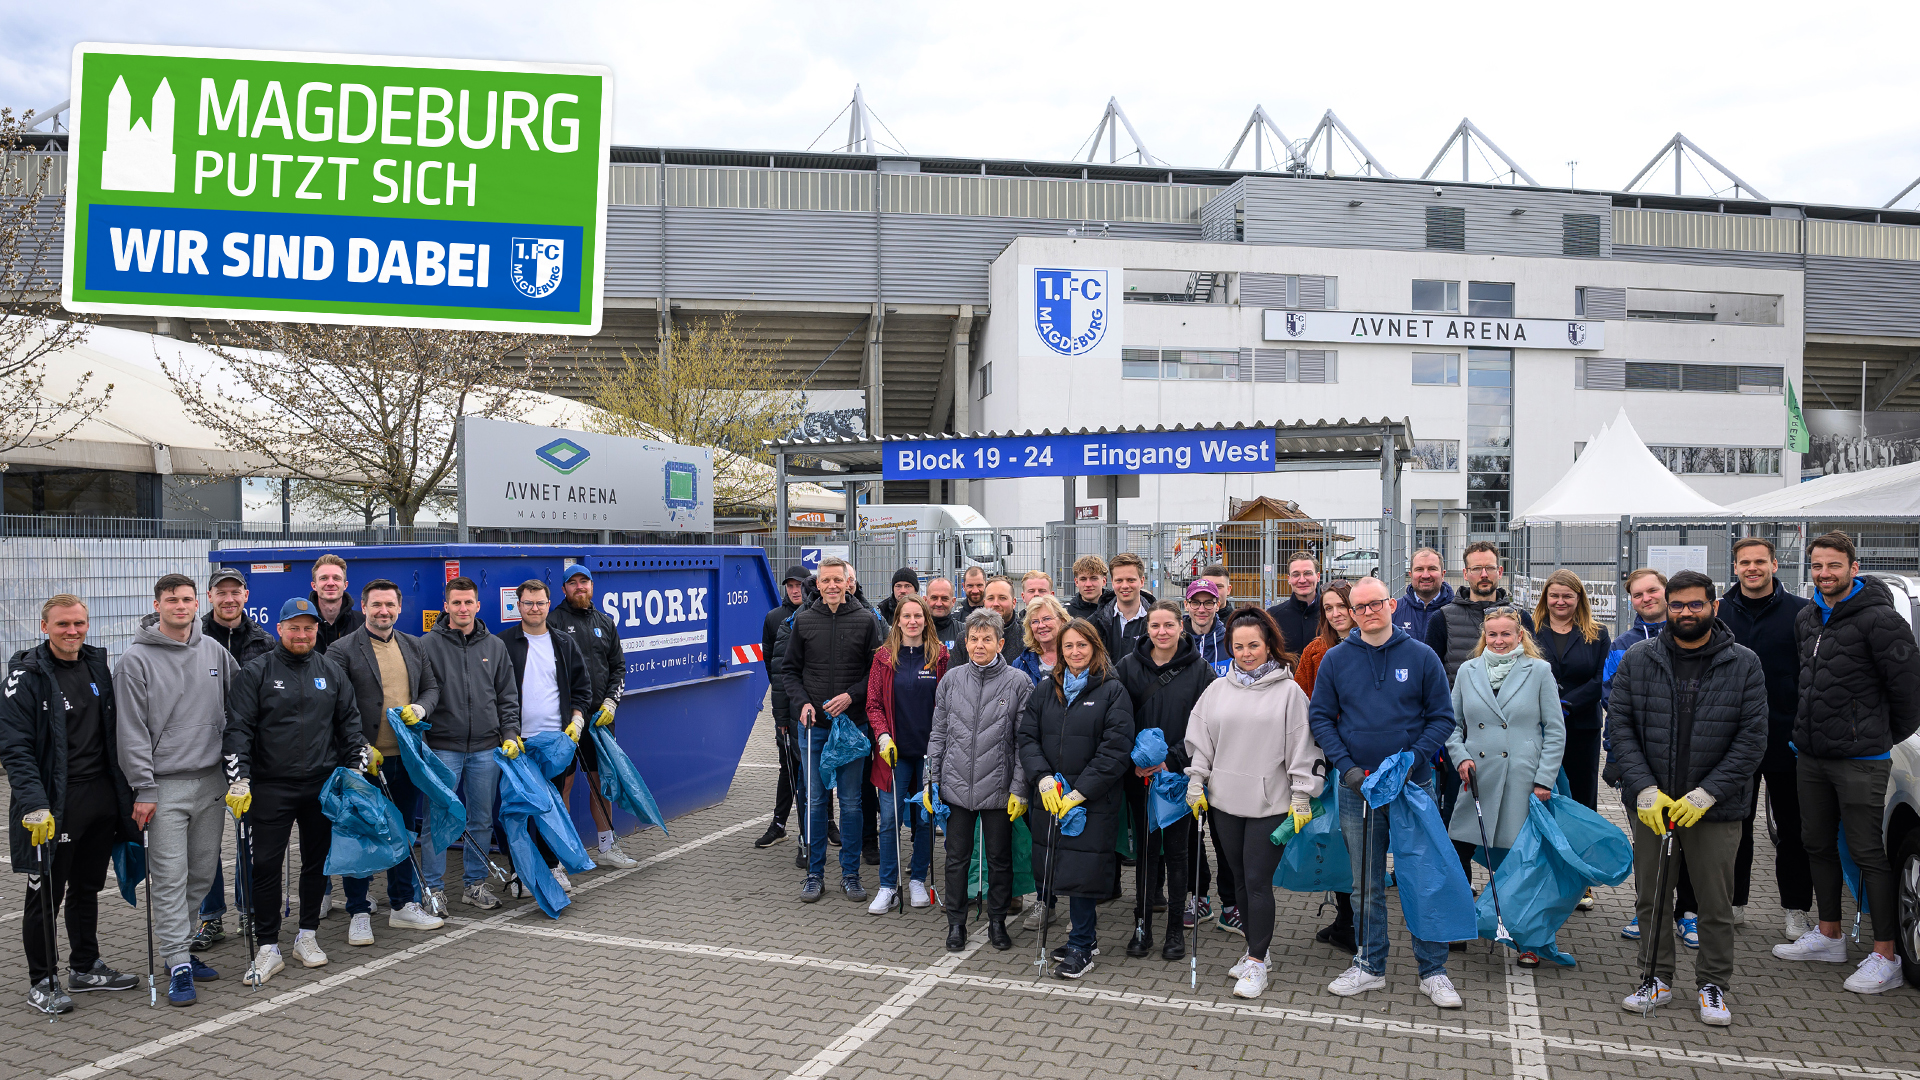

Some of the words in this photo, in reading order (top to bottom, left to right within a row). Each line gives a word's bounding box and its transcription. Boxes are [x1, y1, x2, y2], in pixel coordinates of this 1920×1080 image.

[1039, 306, 1103, 350] MAGDEBURG
[1350, 318, 1434, 338] AVNET
[1446, 320, 1527, 341] ARENA
[898, 448, 966, 471] Block
[973, 447, 1001, 469] 19
[1024, 445, 1054, 468] 24
[1083, 442, 1192, 470] Eingang
[1200, 440, 1270, 462] West
[505, 482, 560, 501] AVNET
[568, 486, 618, 504] ARENA
[518, 510, 608, 520] MAGDEBURG
[602, 587, 708, 627] STORK
[726, 590, 748, 606] 1056
